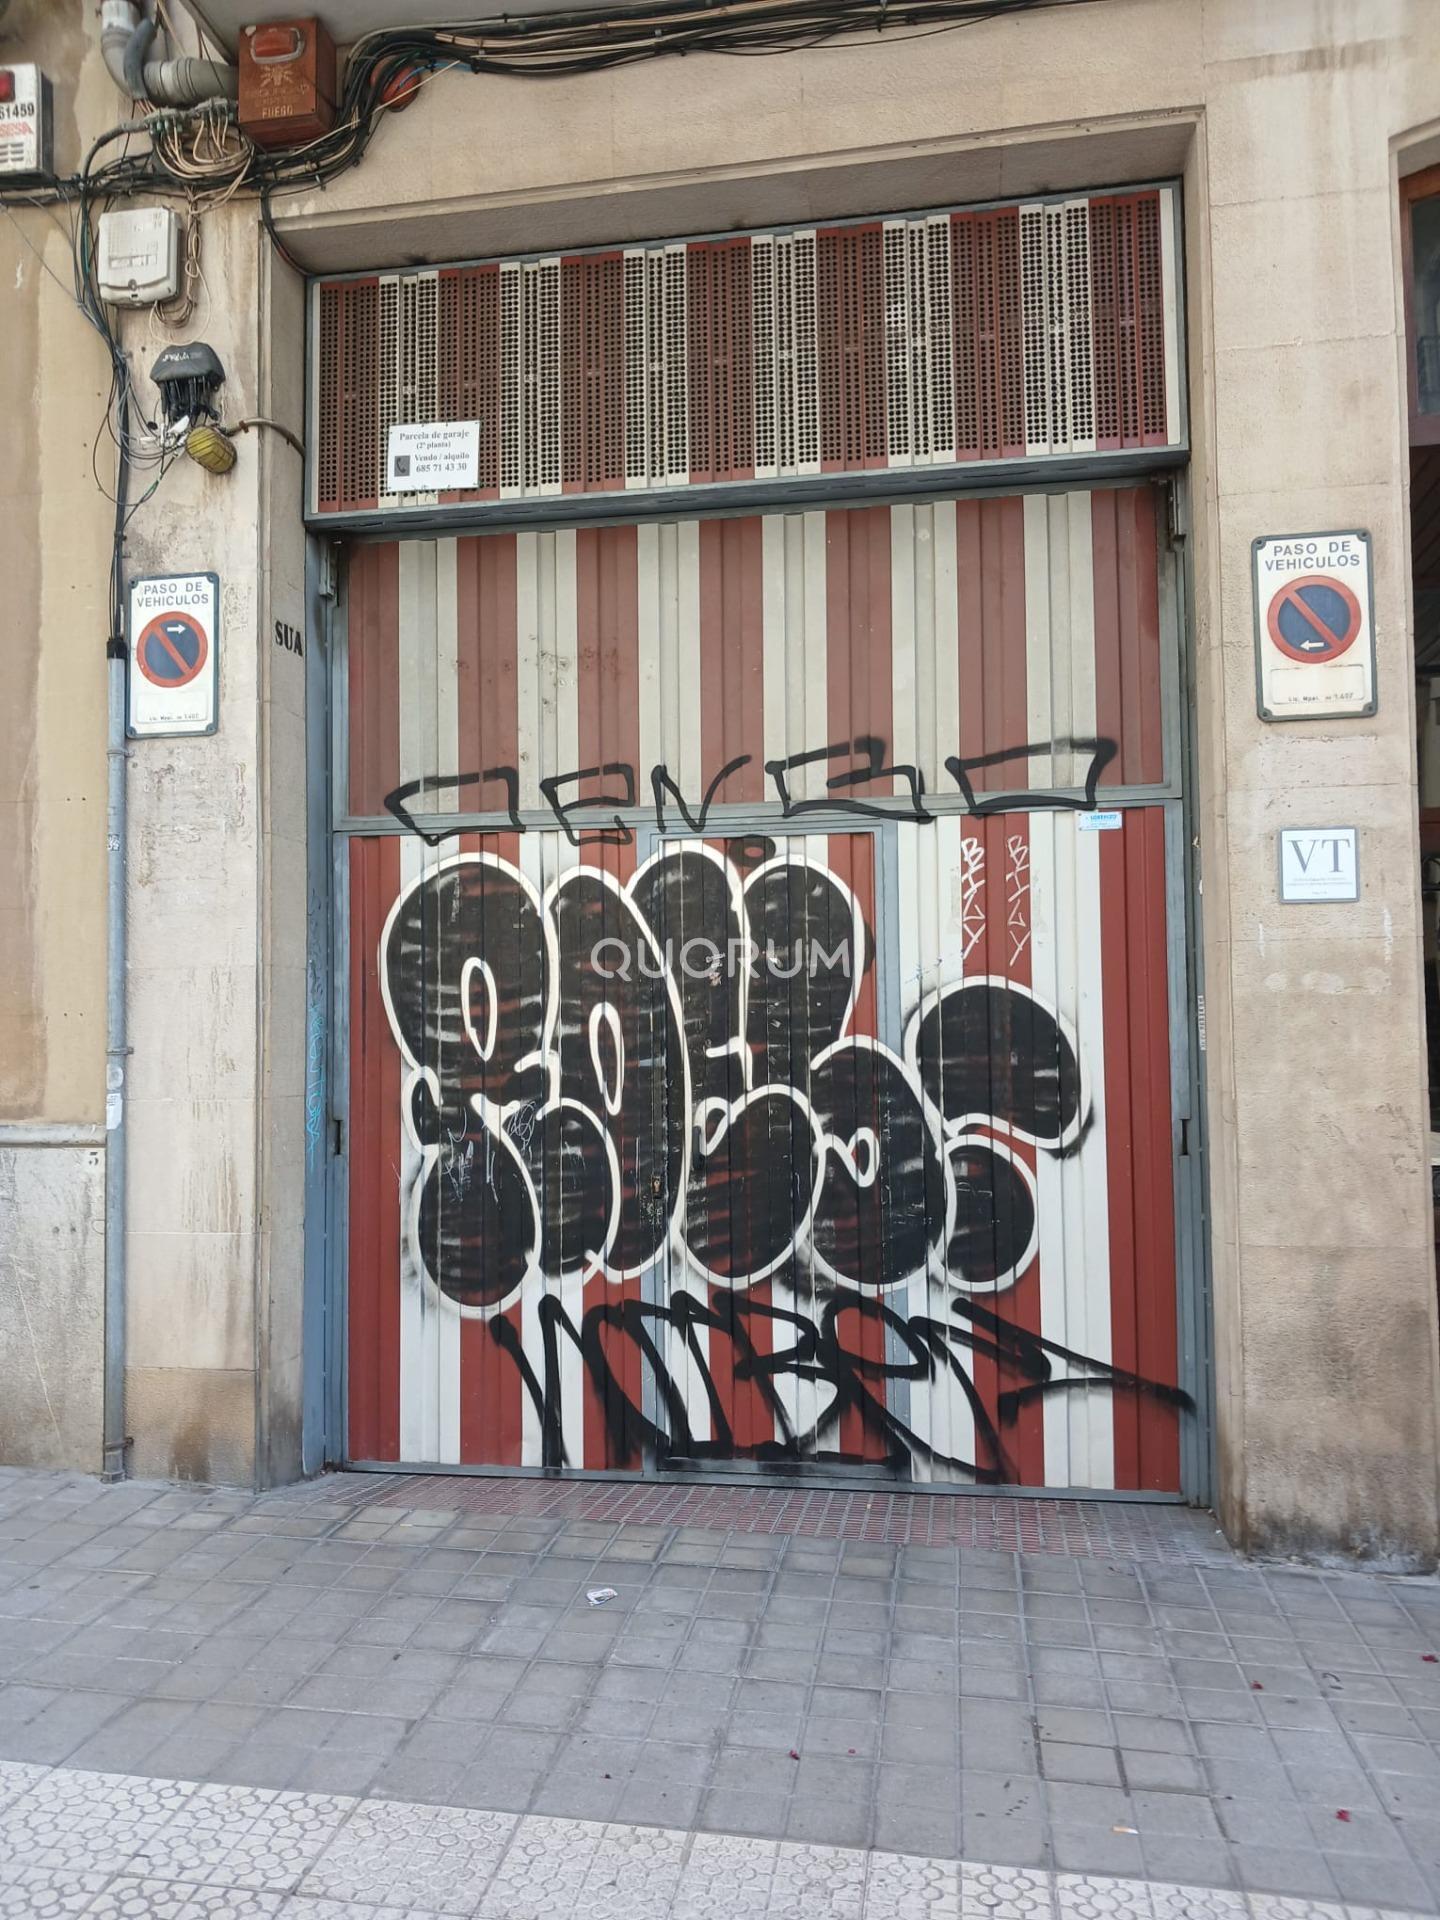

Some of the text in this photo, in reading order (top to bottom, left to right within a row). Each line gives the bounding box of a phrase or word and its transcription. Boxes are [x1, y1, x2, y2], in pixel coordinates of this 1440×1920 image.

[400, 429, 470, 441] Parcela de garaje
[414, 454, 437, 462] Vendo
[416, 462, 467, 472] 685 71 43 30
[1273, 540, 1351, 557] PASO DE
[1265, 554, 1360, 571] VEHICULOS
[144, 582, 203, 595] PASO DE
[137, 593, 209, 608] VEHICULOS
[275, 620, 303, 657] SUA
[1288, 838, 1351, 874] VT
